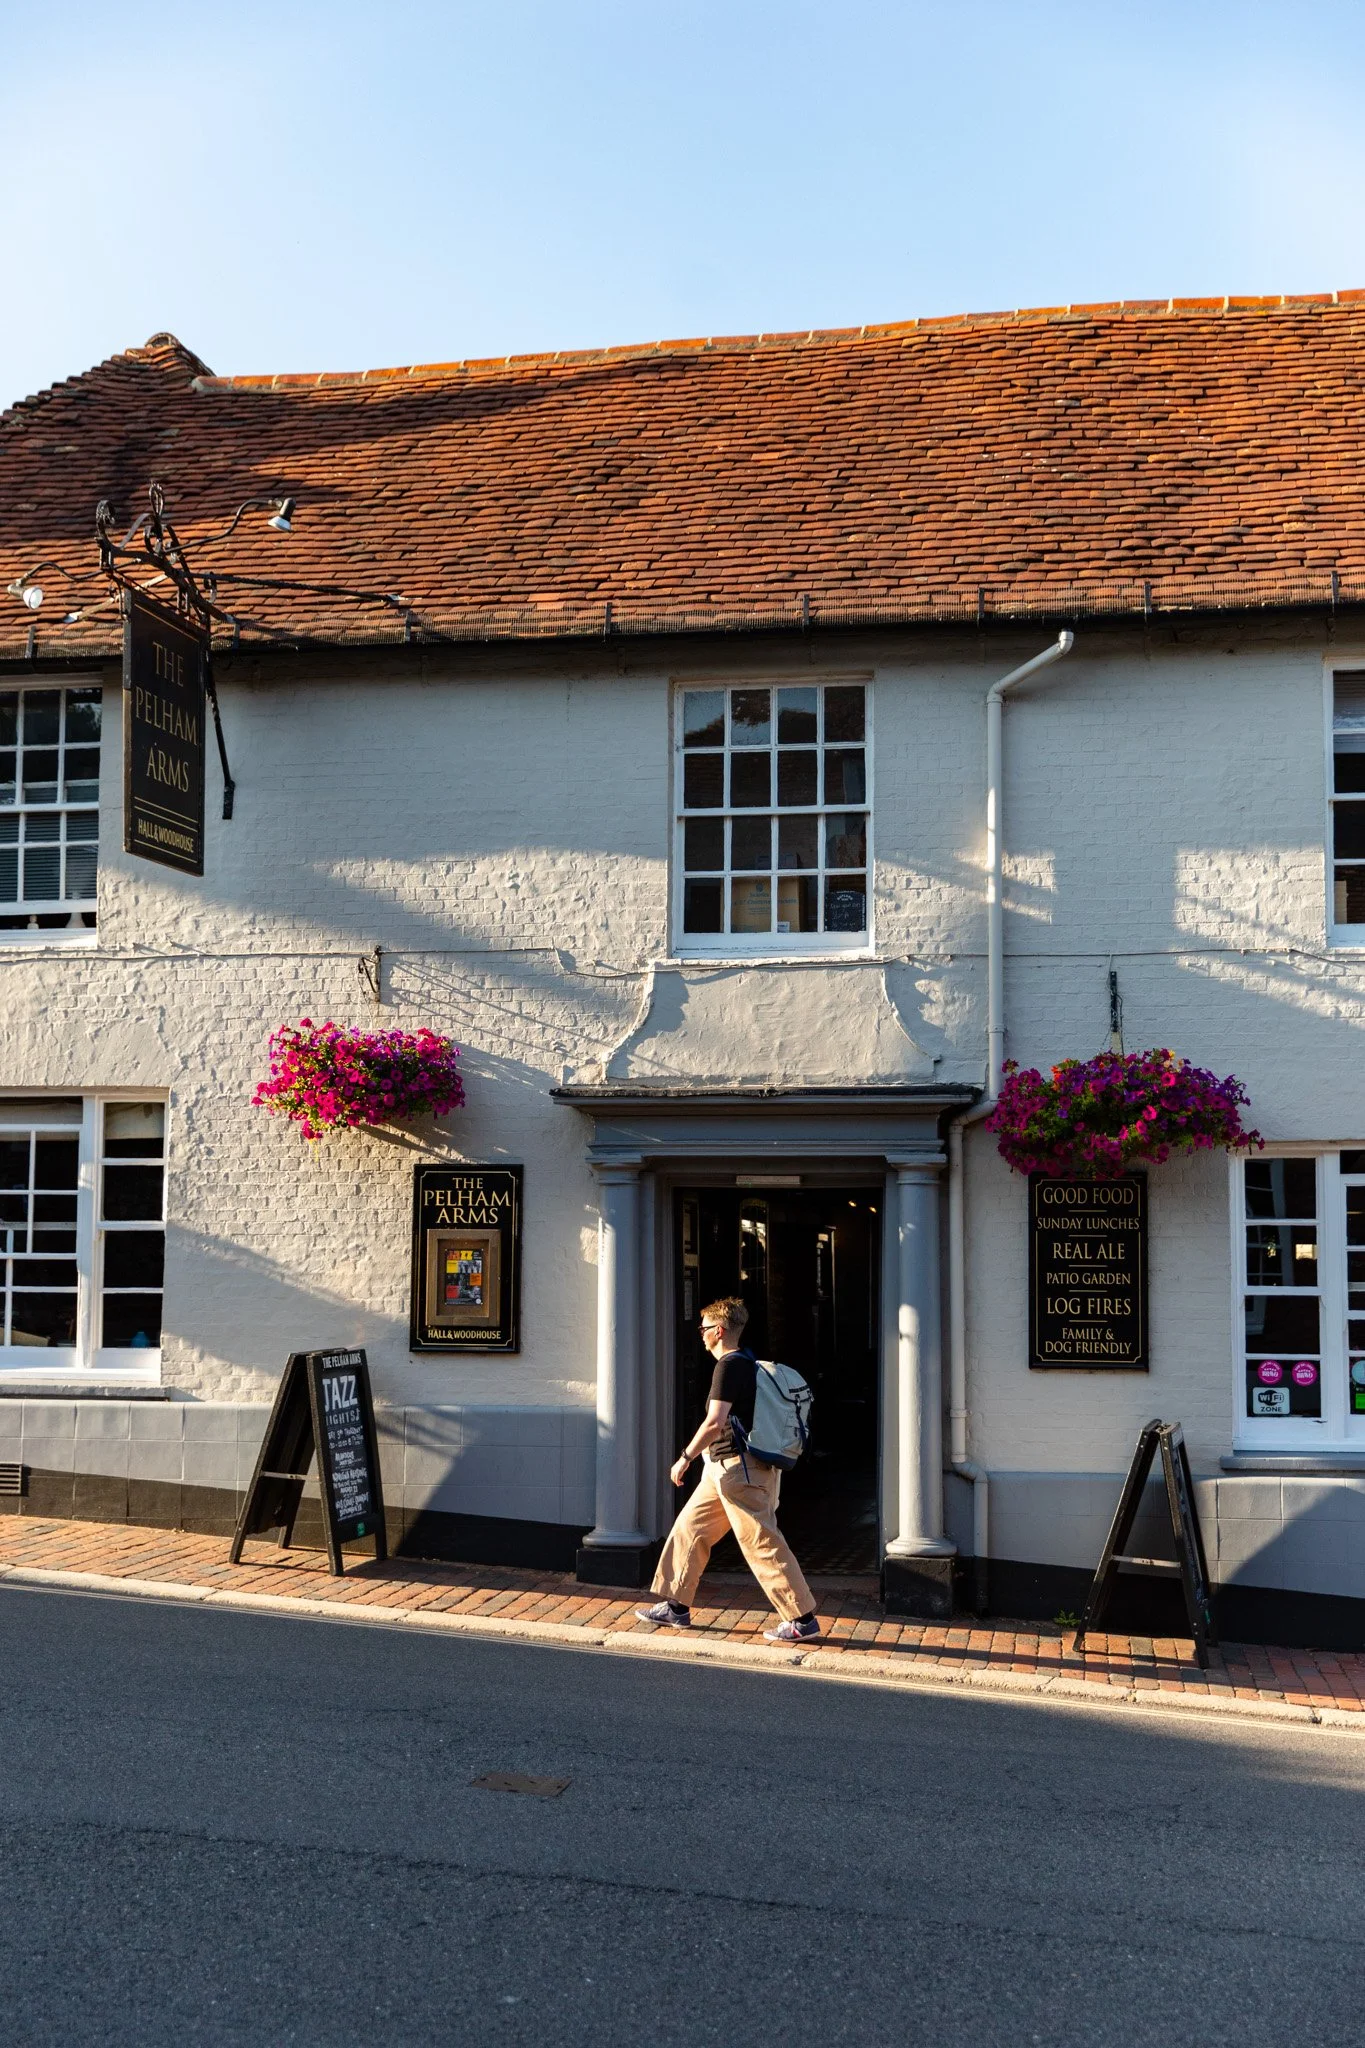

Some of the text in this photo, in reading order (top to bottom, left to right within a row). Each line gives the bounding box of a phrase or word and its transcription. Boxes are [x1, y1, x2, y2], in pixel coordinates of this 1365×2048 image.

[153, 641, 184, 687] THE
[135, 686, 198, 746] PELHAM
[146, 747, 189, 793] ARMS
[453, 1177, 484, 1188] THE
[424, 1190, 511, 1207] PELHAM
[1043, 1187, 1134, 1204] GOOD FOOD
[436, 1207, 499, 1224] ARMS
[1037, 1217, 1140, 1230] SUNDAY LUNCHES
[1053, 1242, 1125, 1260] REAL ALE
[1046, 1272, 1131, 1285] PATIO GARDEN
[1047, 1297, 1131, 1316] LOG FIRES
[1062, 1327, 1115, 1340] FAMILY &
[1045, 1341, 1132, 1355] DOG FRIENDLY
[322, 1375, 358, 1411] JAZZ
